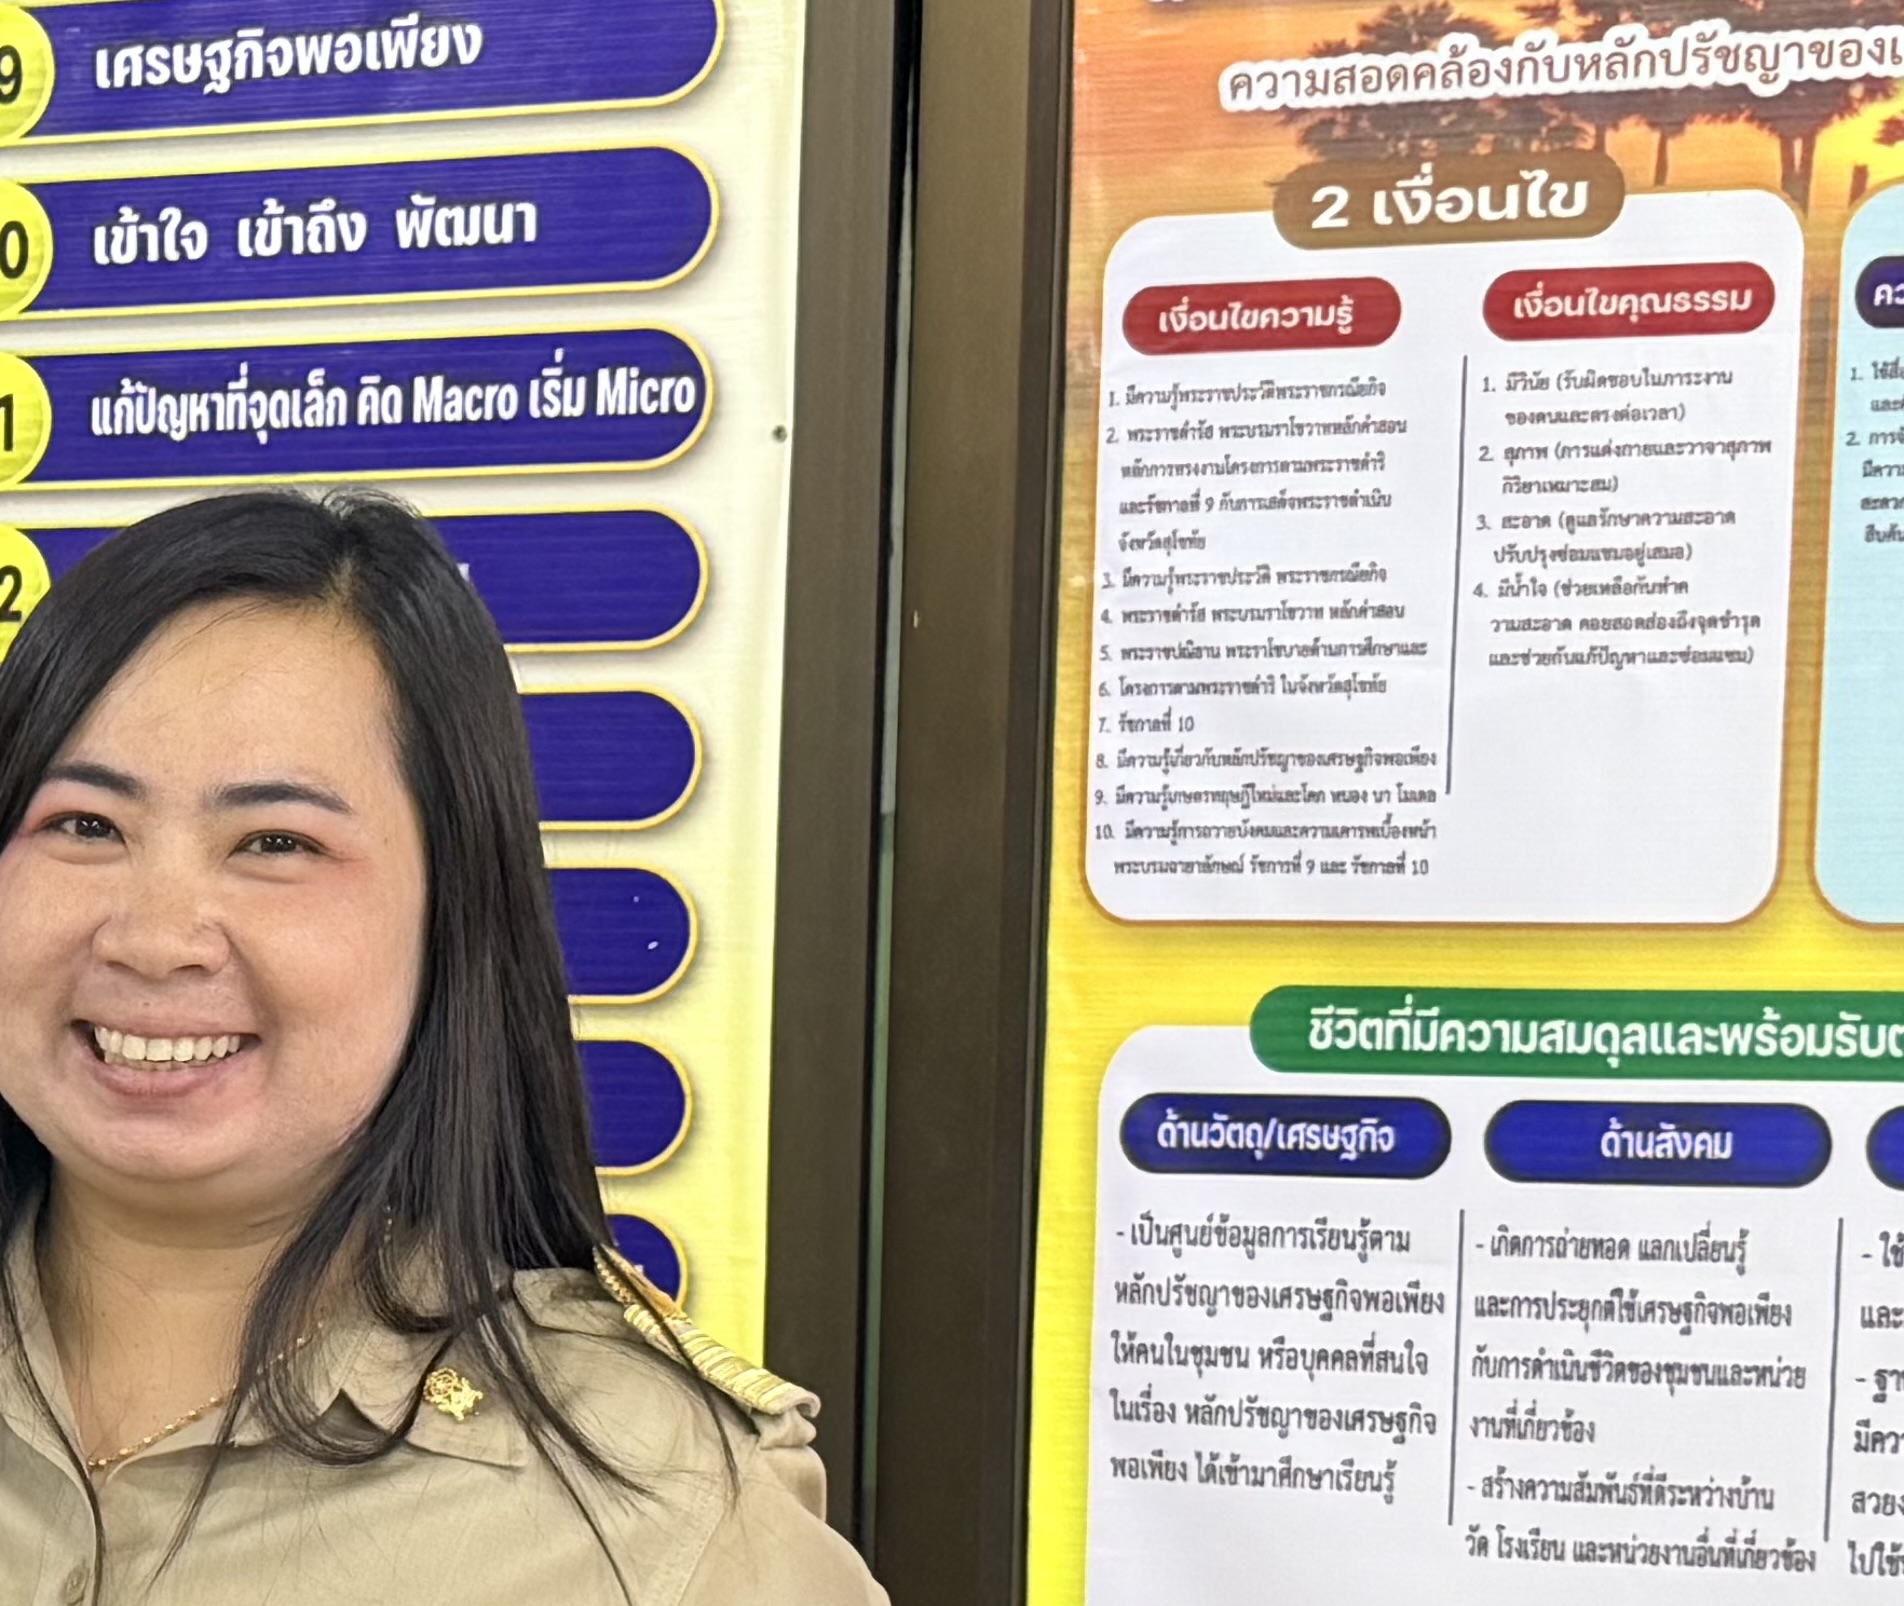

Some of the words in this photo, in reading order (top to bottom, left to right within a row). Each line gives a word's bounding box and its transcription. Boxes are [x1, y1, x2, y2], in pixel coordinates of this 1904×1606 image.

[95, 13, 484, 96] เศรษฐกิจพอเพียง
[1309, 185, 1350, 230] 2
[1372, 162, 1591, 228] เงื่อนไข
[94, 205, 209, 266] เข้าใจ
[237, 200, 368, 259] เข้าถึง
[395, 192, 539, 251] พัฒนา
[1157, 293, 1355, 338] เงื่อนไขความรู้
[1512, 279, 1754, 326] เงื่อนไขคุณธรรม
[91, 361, 348, 446] แก้ปัญหาที่จุดเล็ก
[357, 378, 403, 428] คิด
[412, 380, 519, 424] Macro
[529, 349, 589, 421] เริ่ม
[596, 366, 696, 417] Micro
[1177, 716, 1196, 733] 10
[1411, 858, 1430, 876] 10
[1156, 1108, 1396, 1161] ด้านวัตถุ/เศรษฐกิจ
[1599, 1116, 1734, 1161] ด้านสังคม
[1113, 1271, 1446, 1322] หลักปรัชญาของเศรษฐกิจพอเพียง
[1109, 1329, 1251, 1379] ให้คนในชุมชน
[1108, 1383, 1177, 1425] ในเรื่อง
[1183, 1393, 1438, 1446] หลักปรัชญาของเศรษฐกิจ
[1109, 1448, 1188, 1483] พอเพียง
